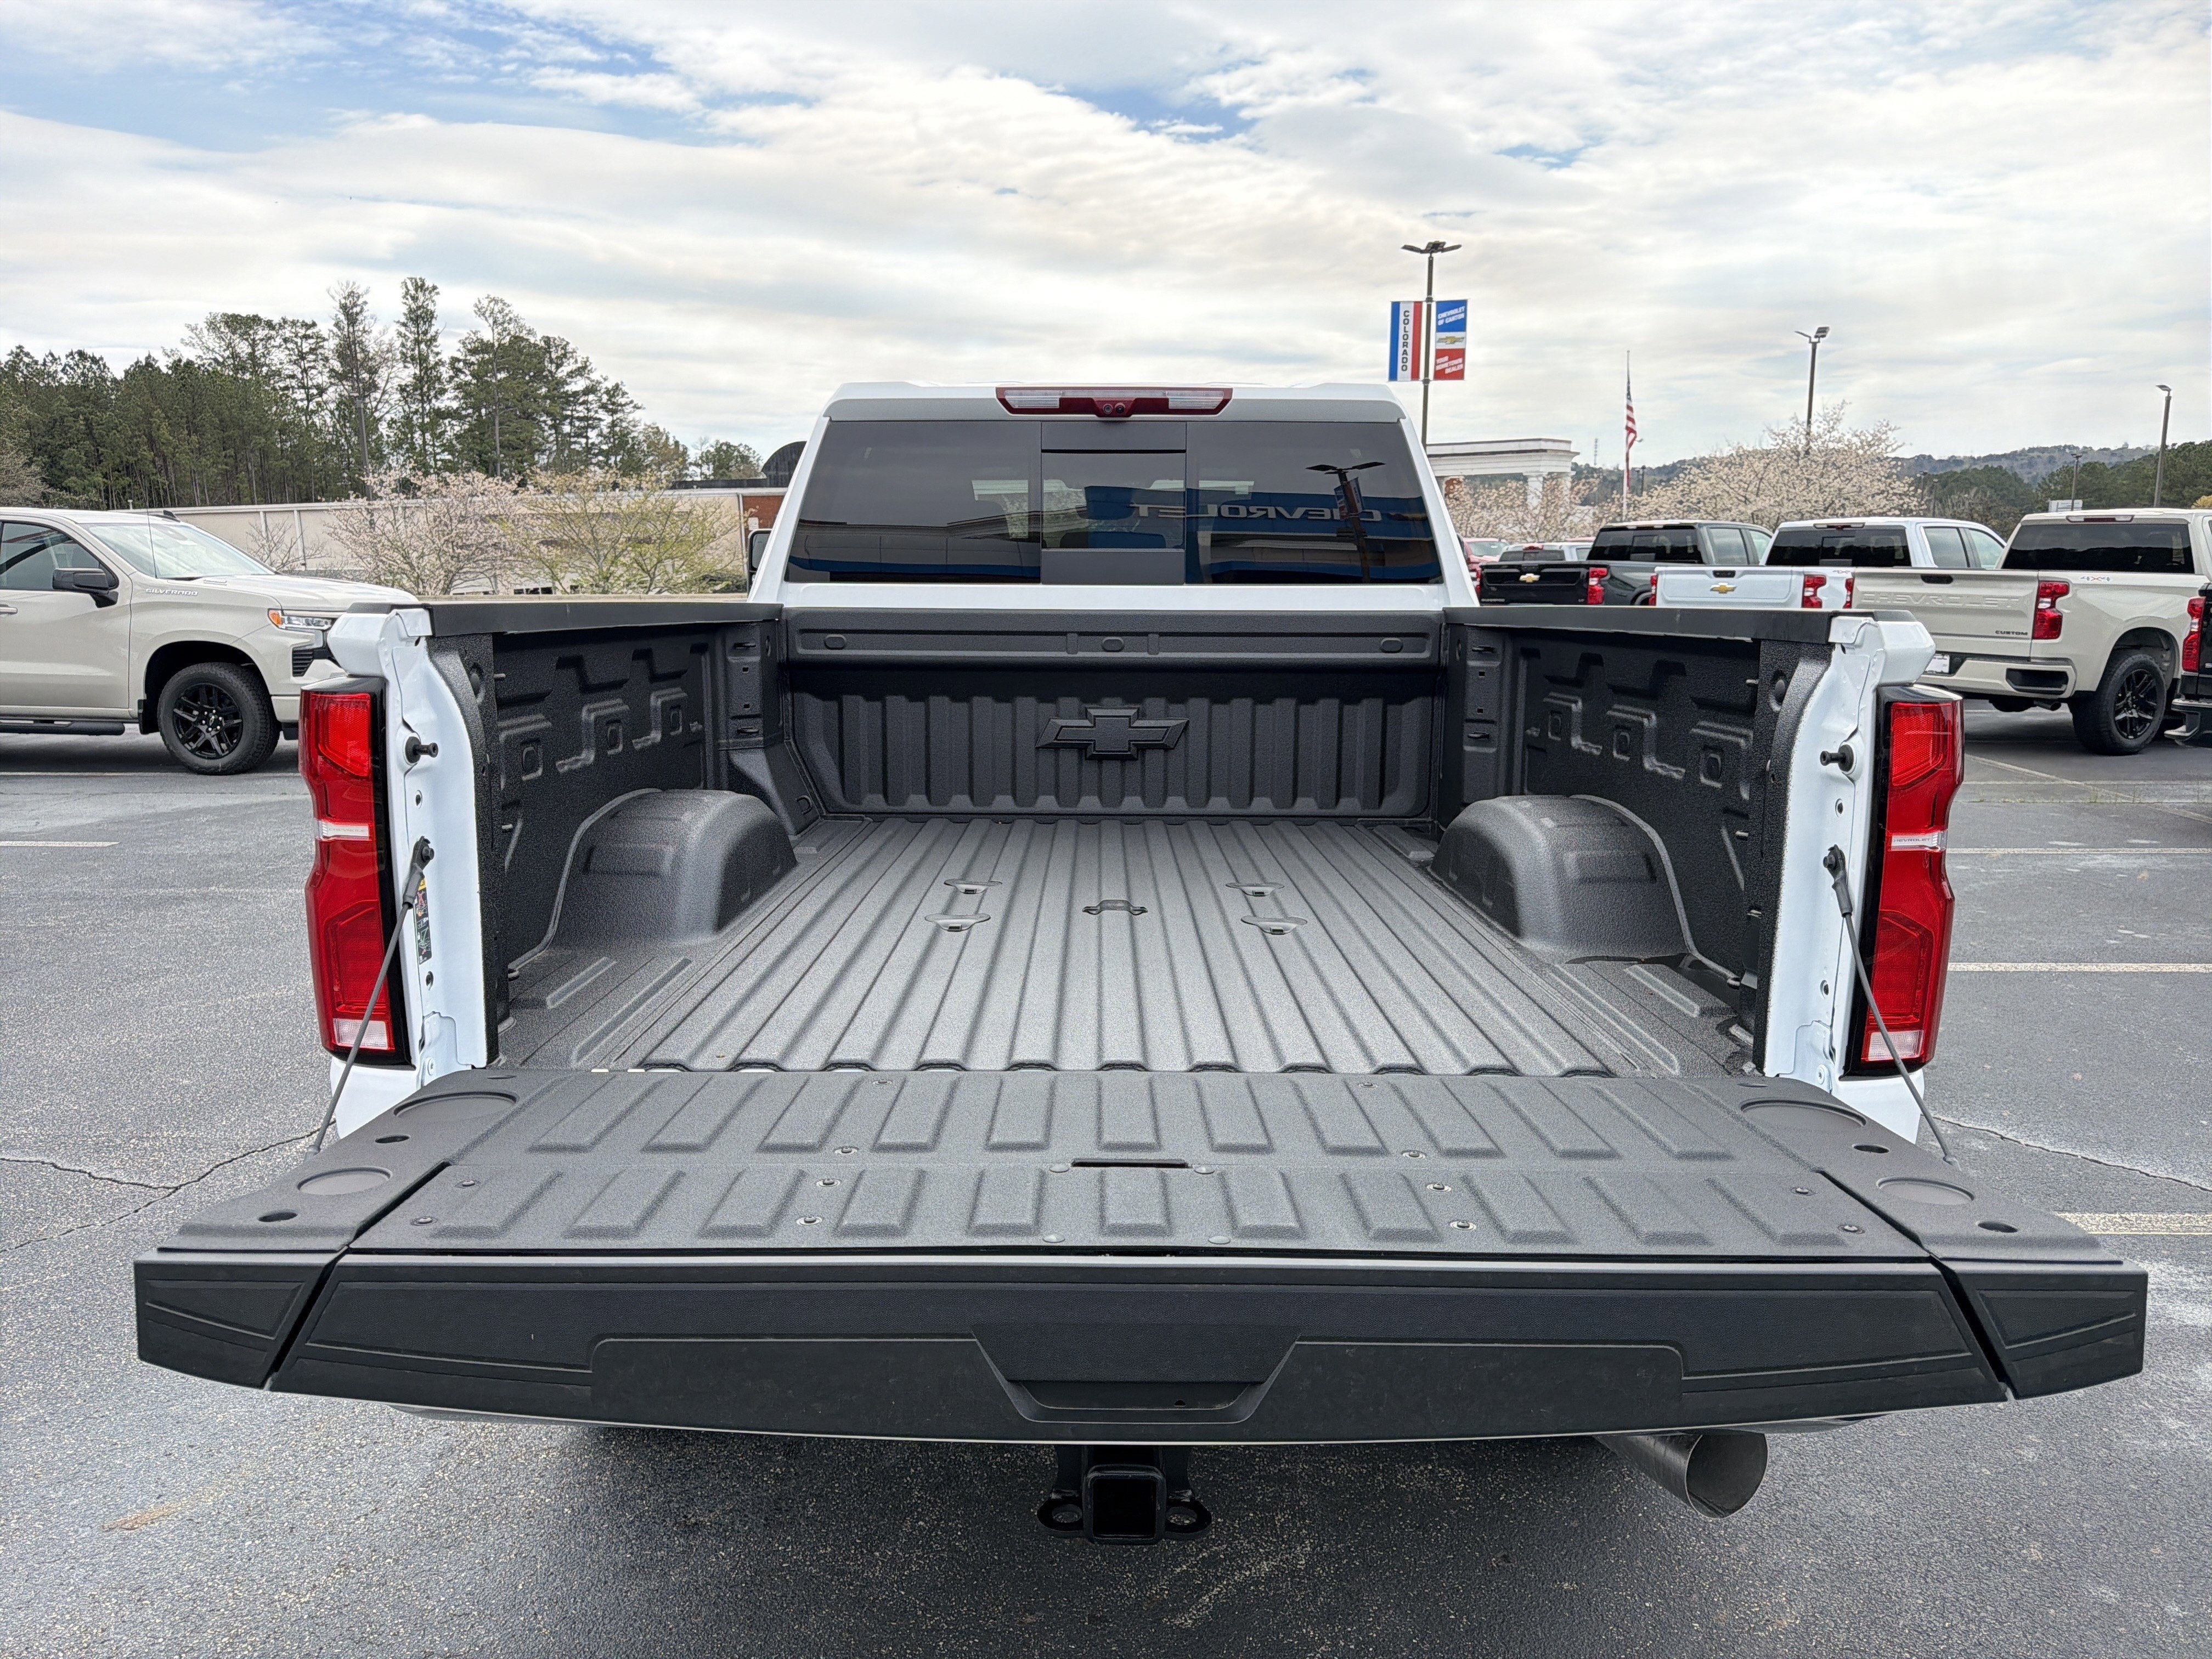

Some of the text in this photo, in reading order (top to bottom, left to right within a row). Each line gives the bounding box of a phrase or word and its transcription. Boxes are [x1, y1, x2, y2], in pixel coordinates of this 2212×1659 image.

[1401, 310, 1410, 372] COLORADO
[145, 588, 198, 596] SILVERADO
[1861, 593, 2020, 607] CHEVROLET
